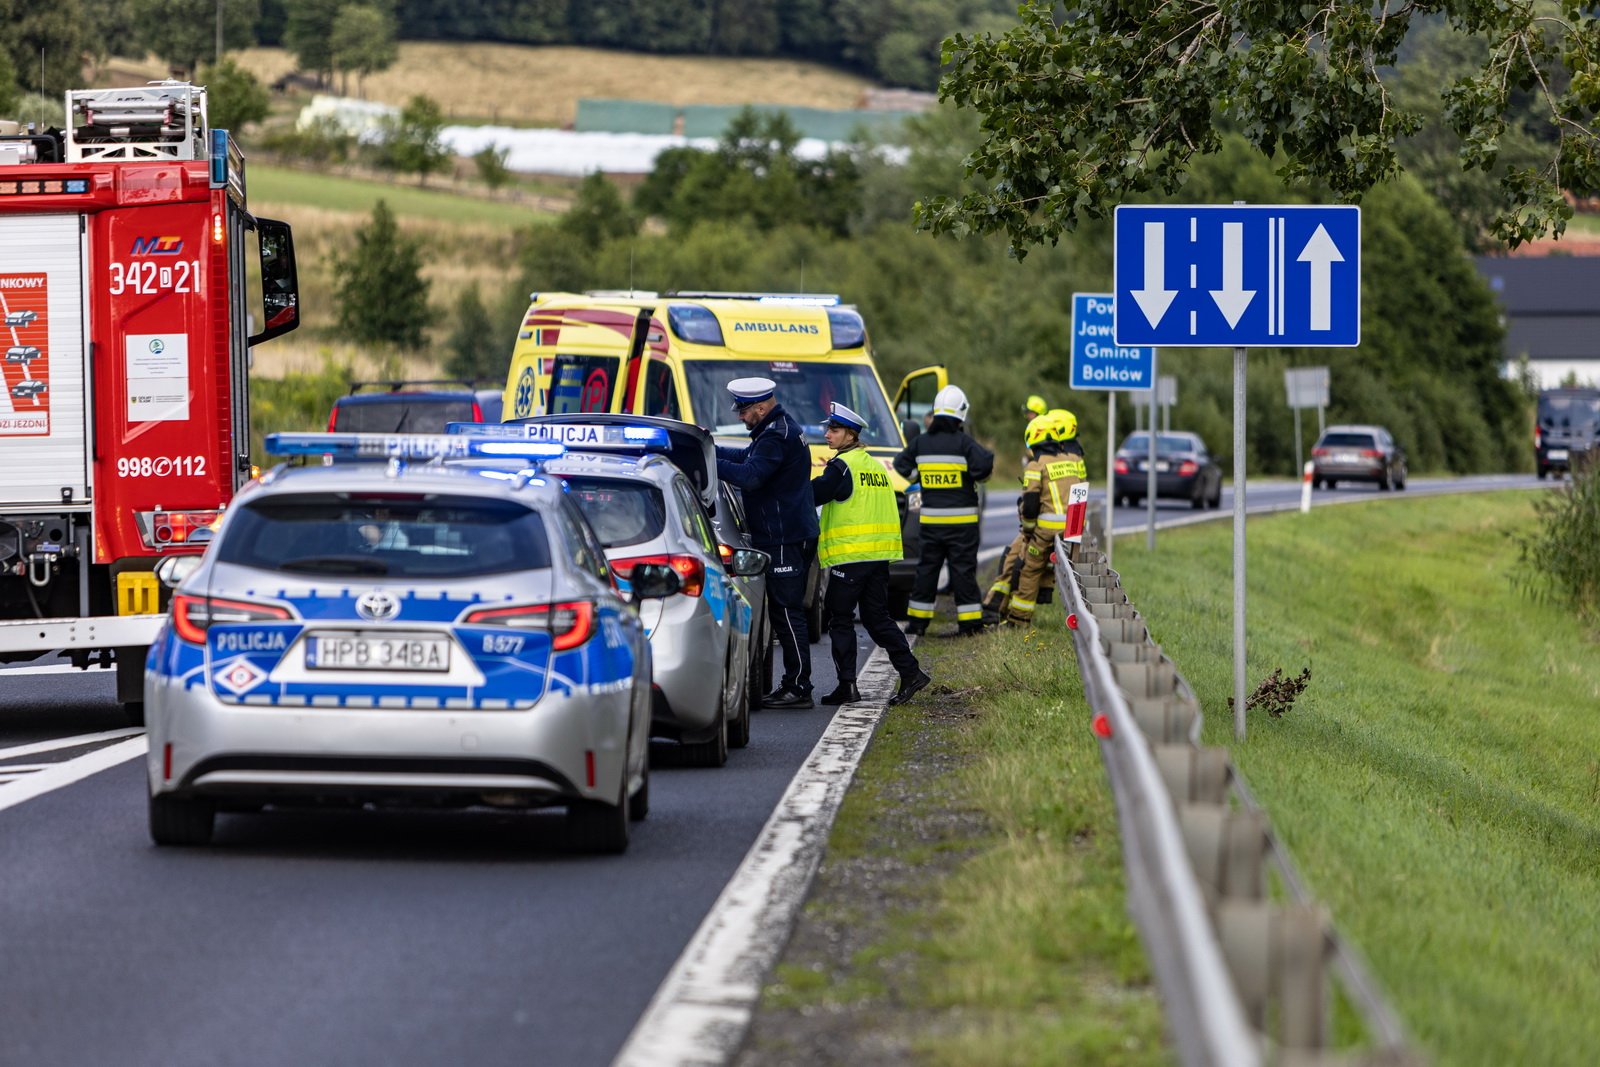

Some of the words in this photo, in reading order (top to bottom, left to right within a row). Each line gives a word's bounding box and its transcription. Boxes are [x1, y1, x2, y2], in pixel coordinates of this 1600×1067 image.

[109, 261, 158, 295] 342
[174, 260, 200, 293] 21
[734, 322, 819, 335] AMBULANS
[1084, 342, 1141, 360] Gmina
[1082, 364, 1143, 382] Bolków
[528, 426, 599, 443] POLICJA
[117, 456, 152, 478] 998
[172, 455, 206, 476] 112
[860, 472, 889, 487] POLICJA
[1072, 488, 1087, 497] 450
[831, 569, 845, 578] POLICJA
[217, 632, 286, 652] POLICJA
[323, 640, 369, 666] HPB
